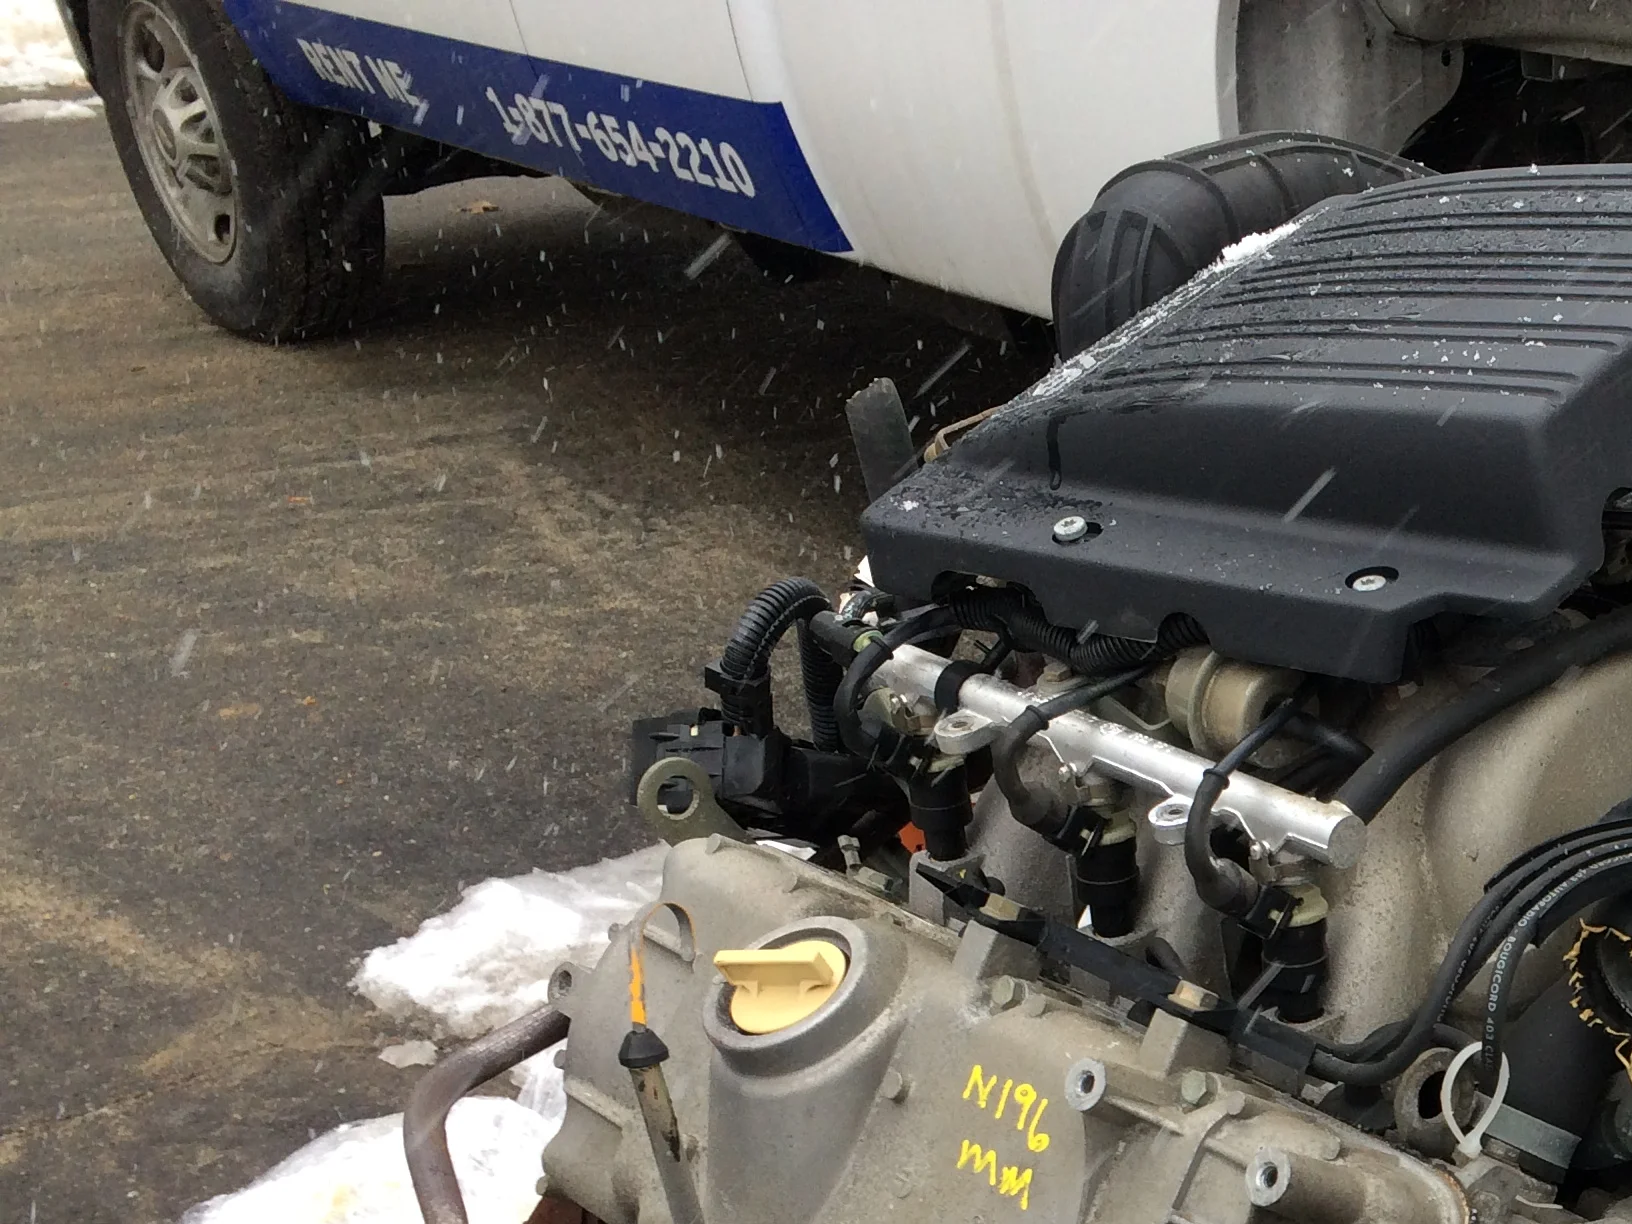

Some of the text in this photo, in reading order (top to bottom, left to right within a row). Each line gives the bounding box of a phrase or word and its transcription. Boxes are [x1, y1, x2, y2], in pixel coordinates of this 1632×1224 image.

[296, 38, 421, 107] RENT ME
[485, 86, 755, 199] 1-877-654-2210
[1487, 935, 1515, 1012] BOUGICORD
[962, 1064, 1050, 1153] N196
